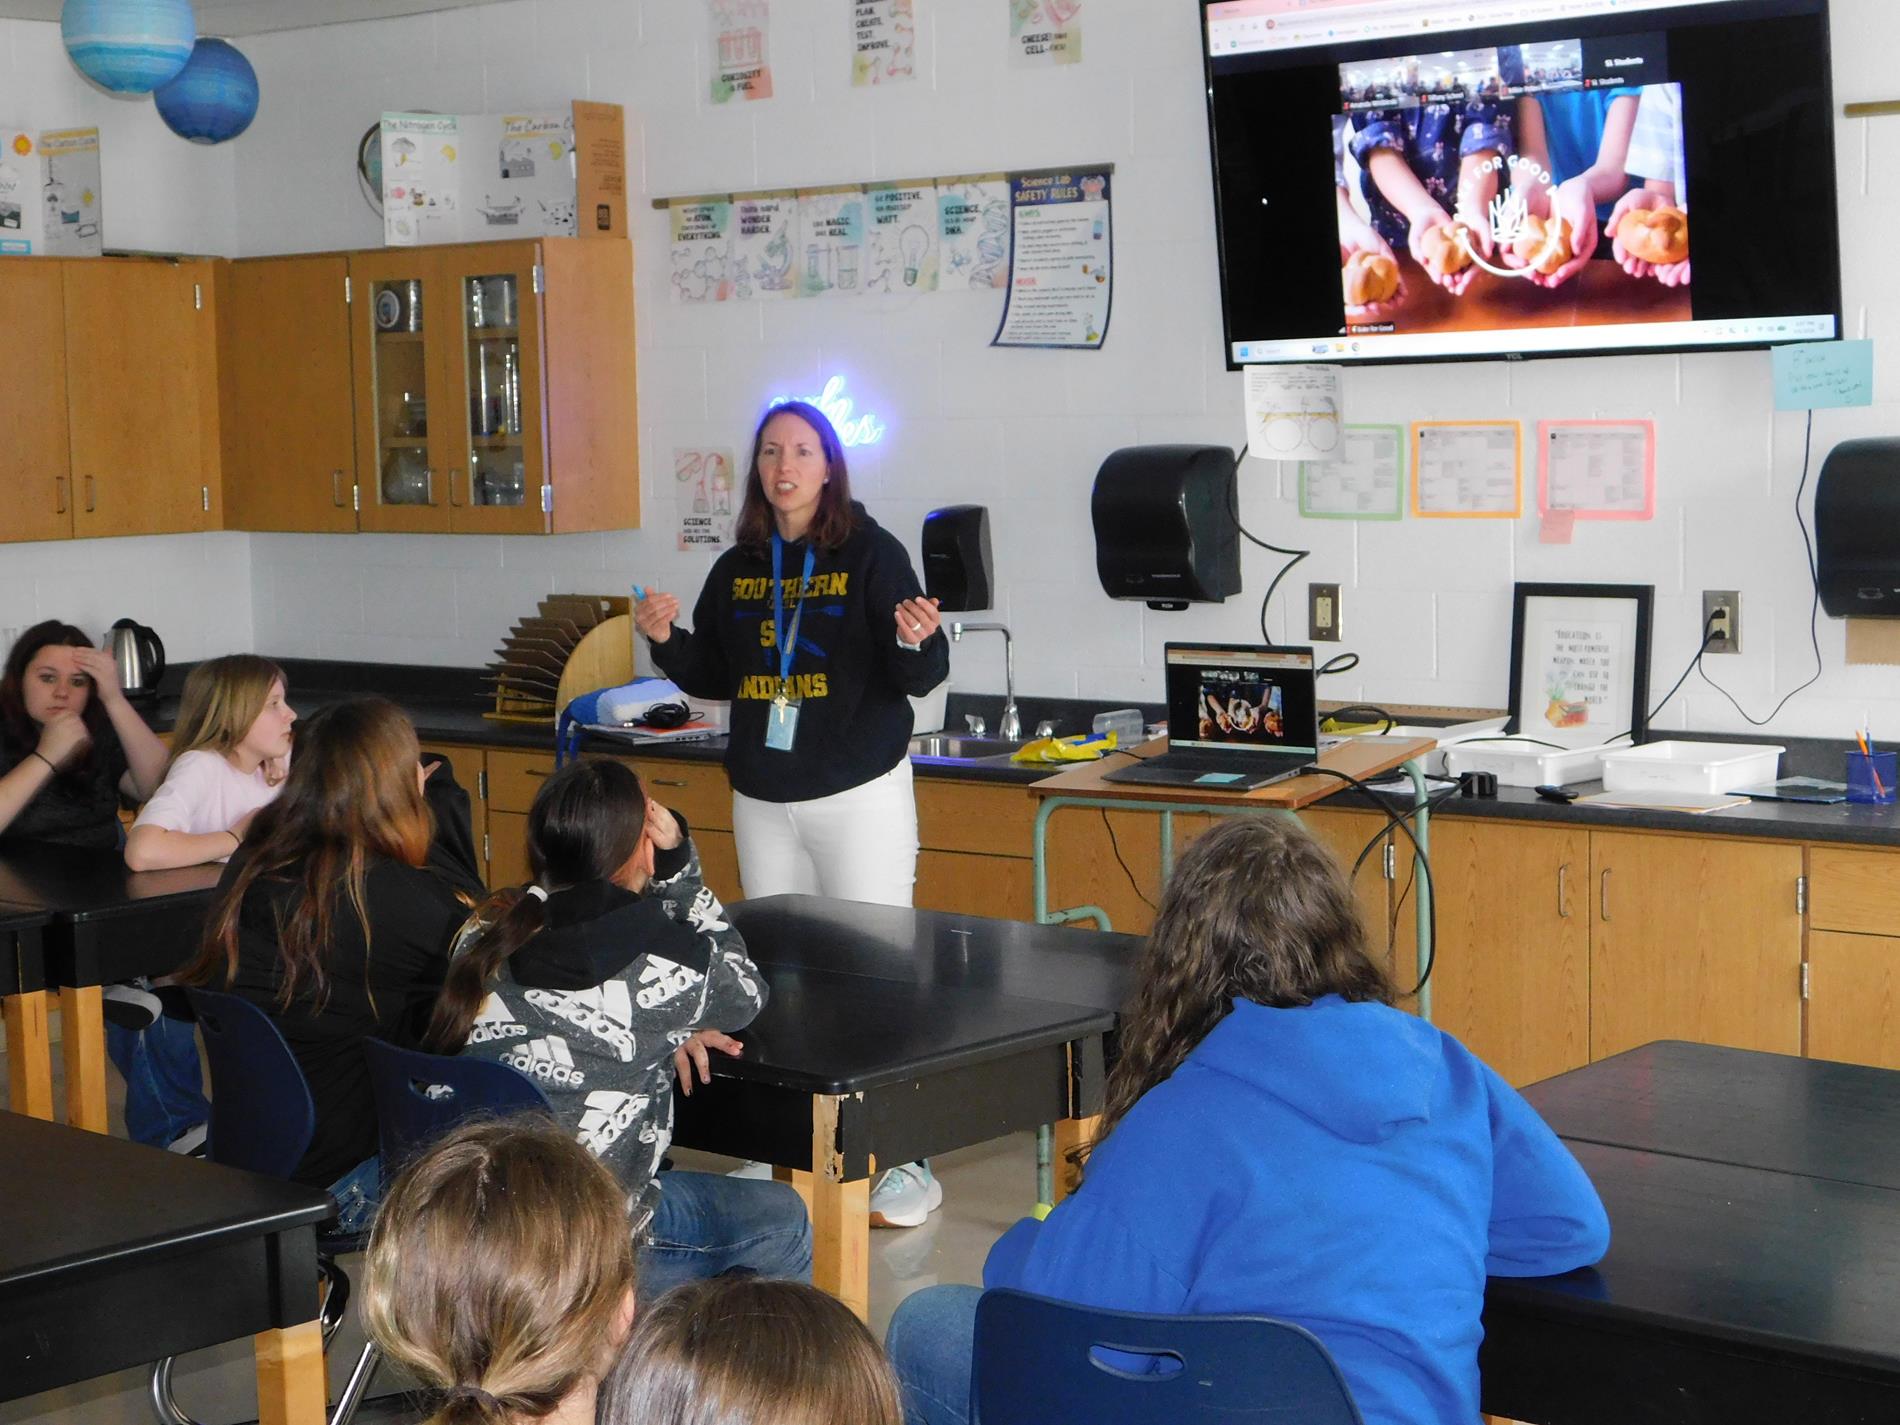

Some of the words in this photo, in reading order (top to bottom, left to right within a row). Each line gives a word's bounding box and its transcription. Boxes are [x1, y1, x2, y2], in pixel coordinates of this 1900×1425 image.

[1473, 156, 1503, 178] FOR
[1507, 154, 1550, 184] GOOD
[1021, 175, 1054, 187] Science
[1015, 188, 1047, 202] SAFETY
[1050, 186, 1078, 199] RULES
[683, 517, 712, 526] SCIENCE
[464, 1021, 528, 1046] didas
